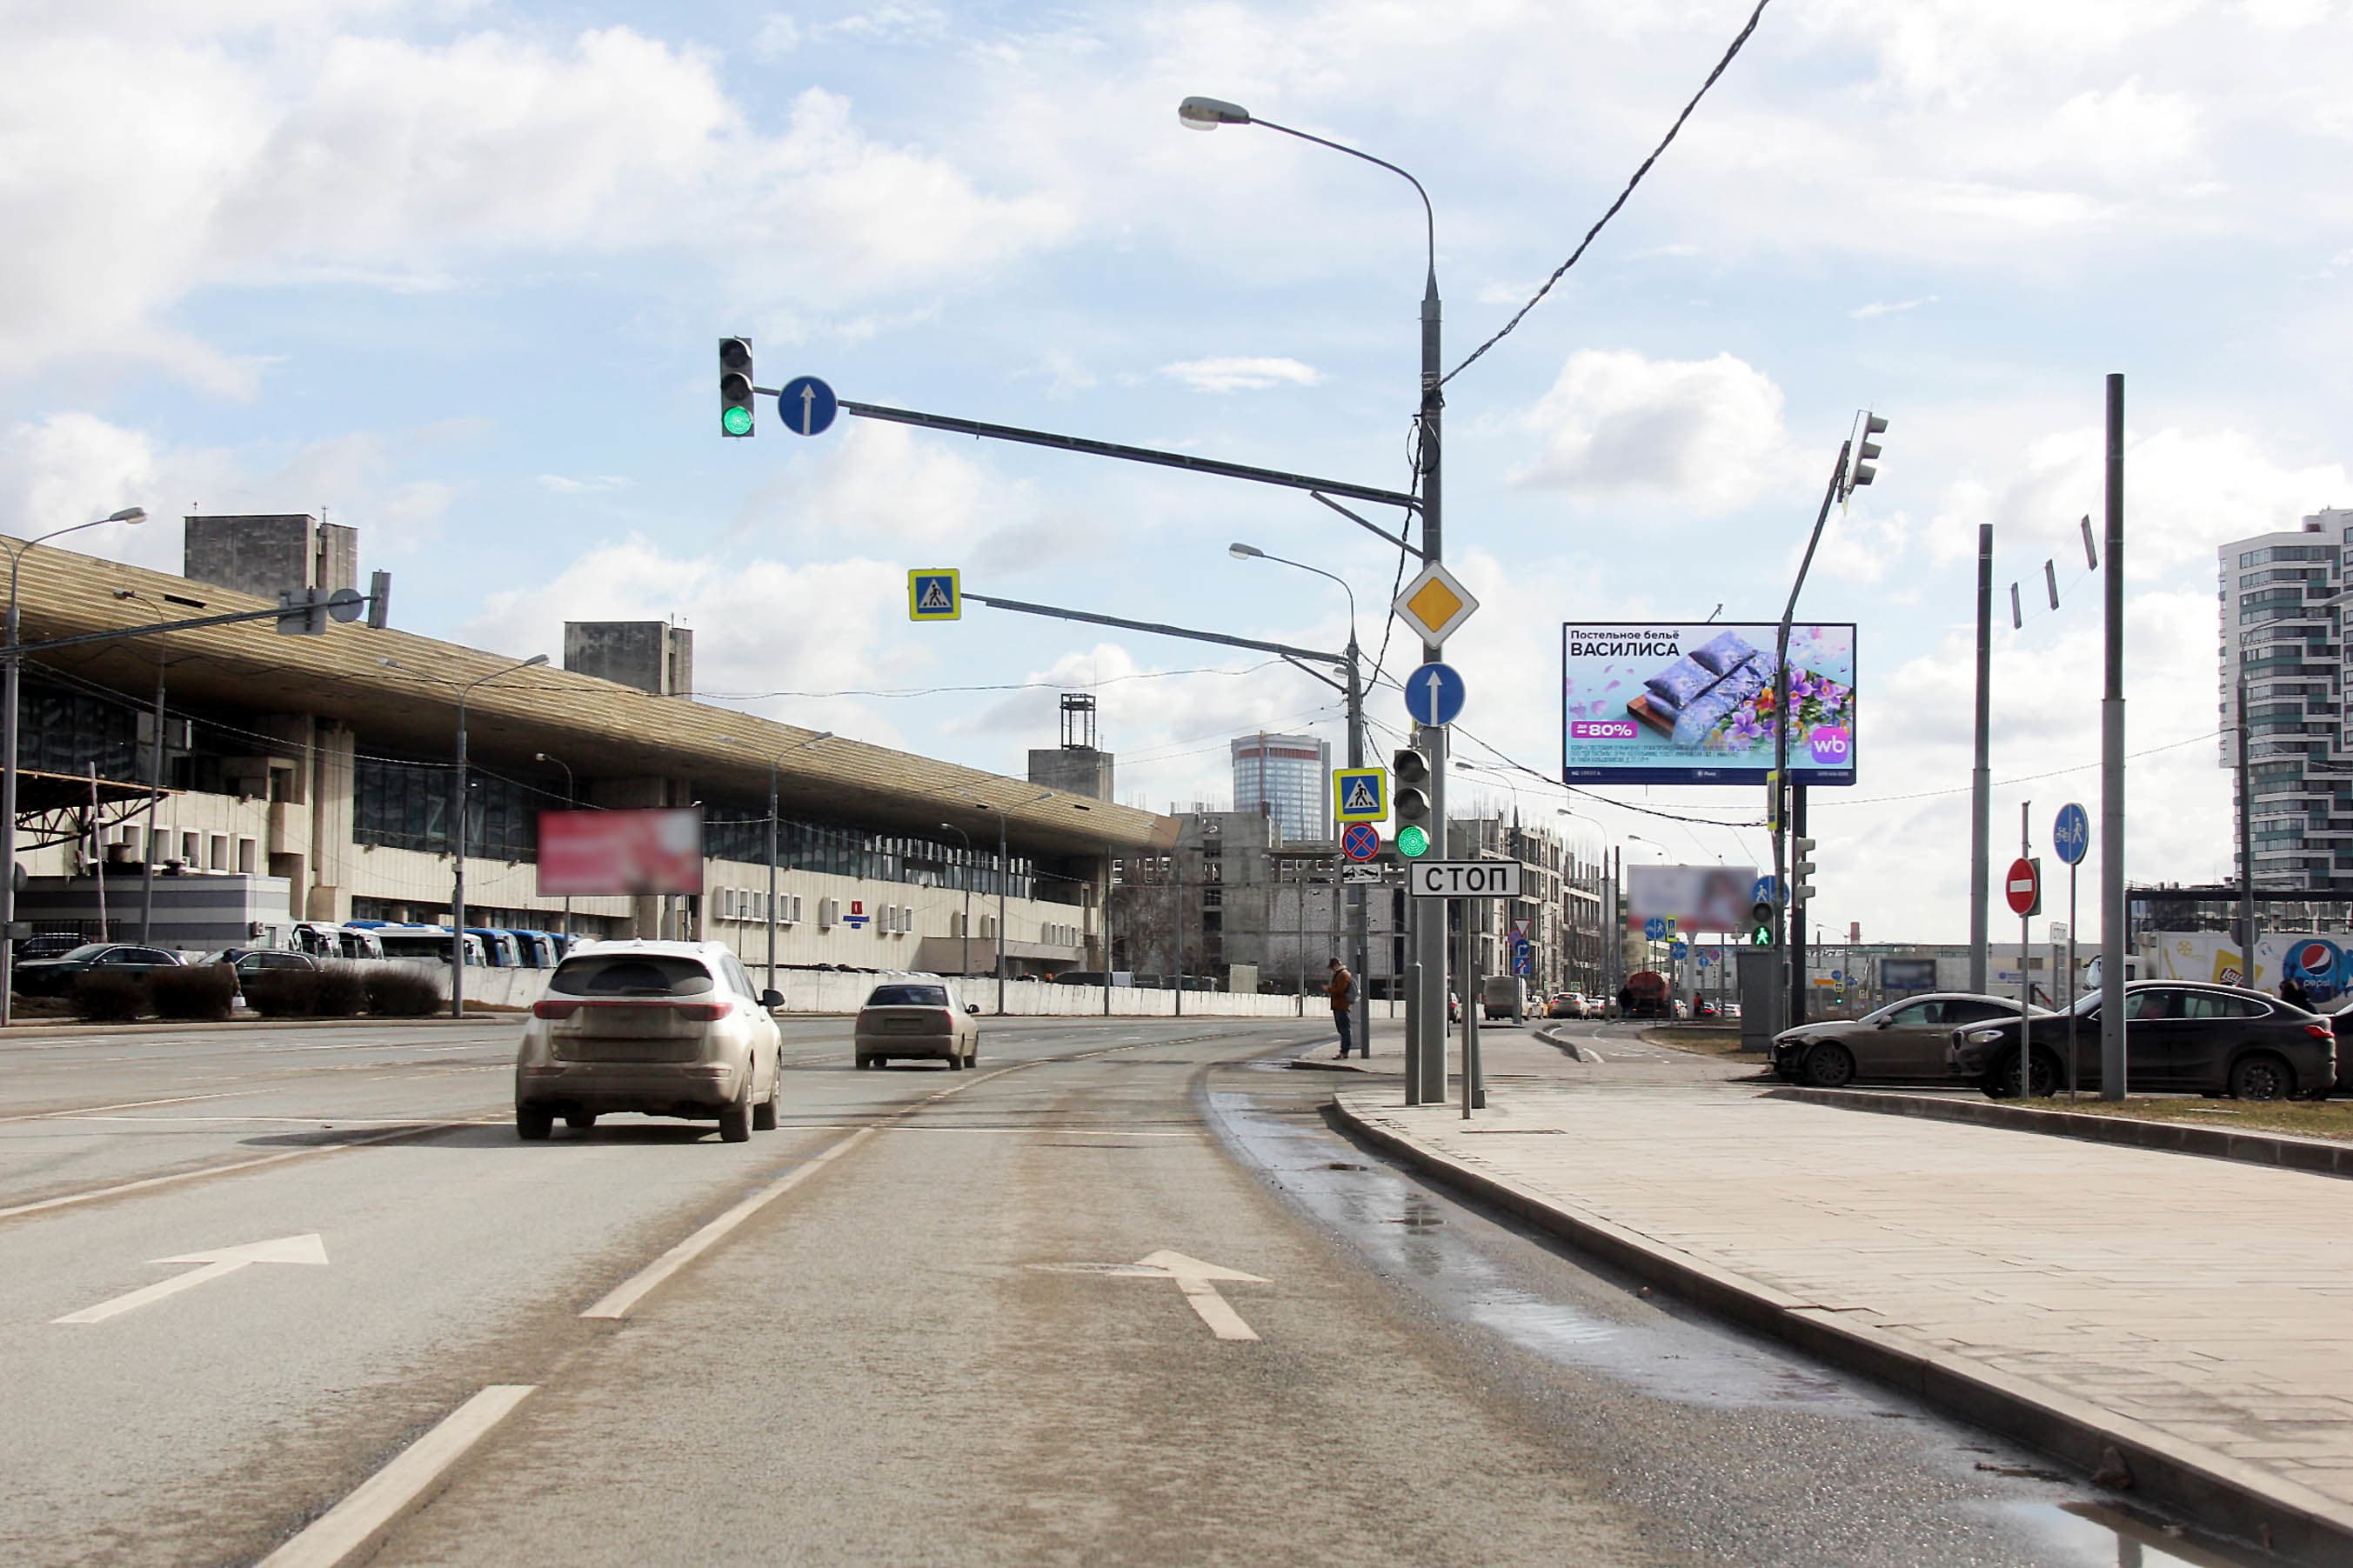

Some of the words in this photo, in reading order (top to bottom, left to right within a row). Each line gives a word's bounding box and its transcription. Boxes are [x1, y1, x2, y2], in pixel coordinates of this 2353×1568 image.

[1570, 630, 1641, 640] Постельное
[1643, 629, 1680, 640] бельё
[1570, 642, 1681, 657] ВАСИЛИСА
[1814, 735, 1846, 753] wb
[1425, 866, 1507, 892] СТОП
[2303, 978, 2331, 988] pepsi
